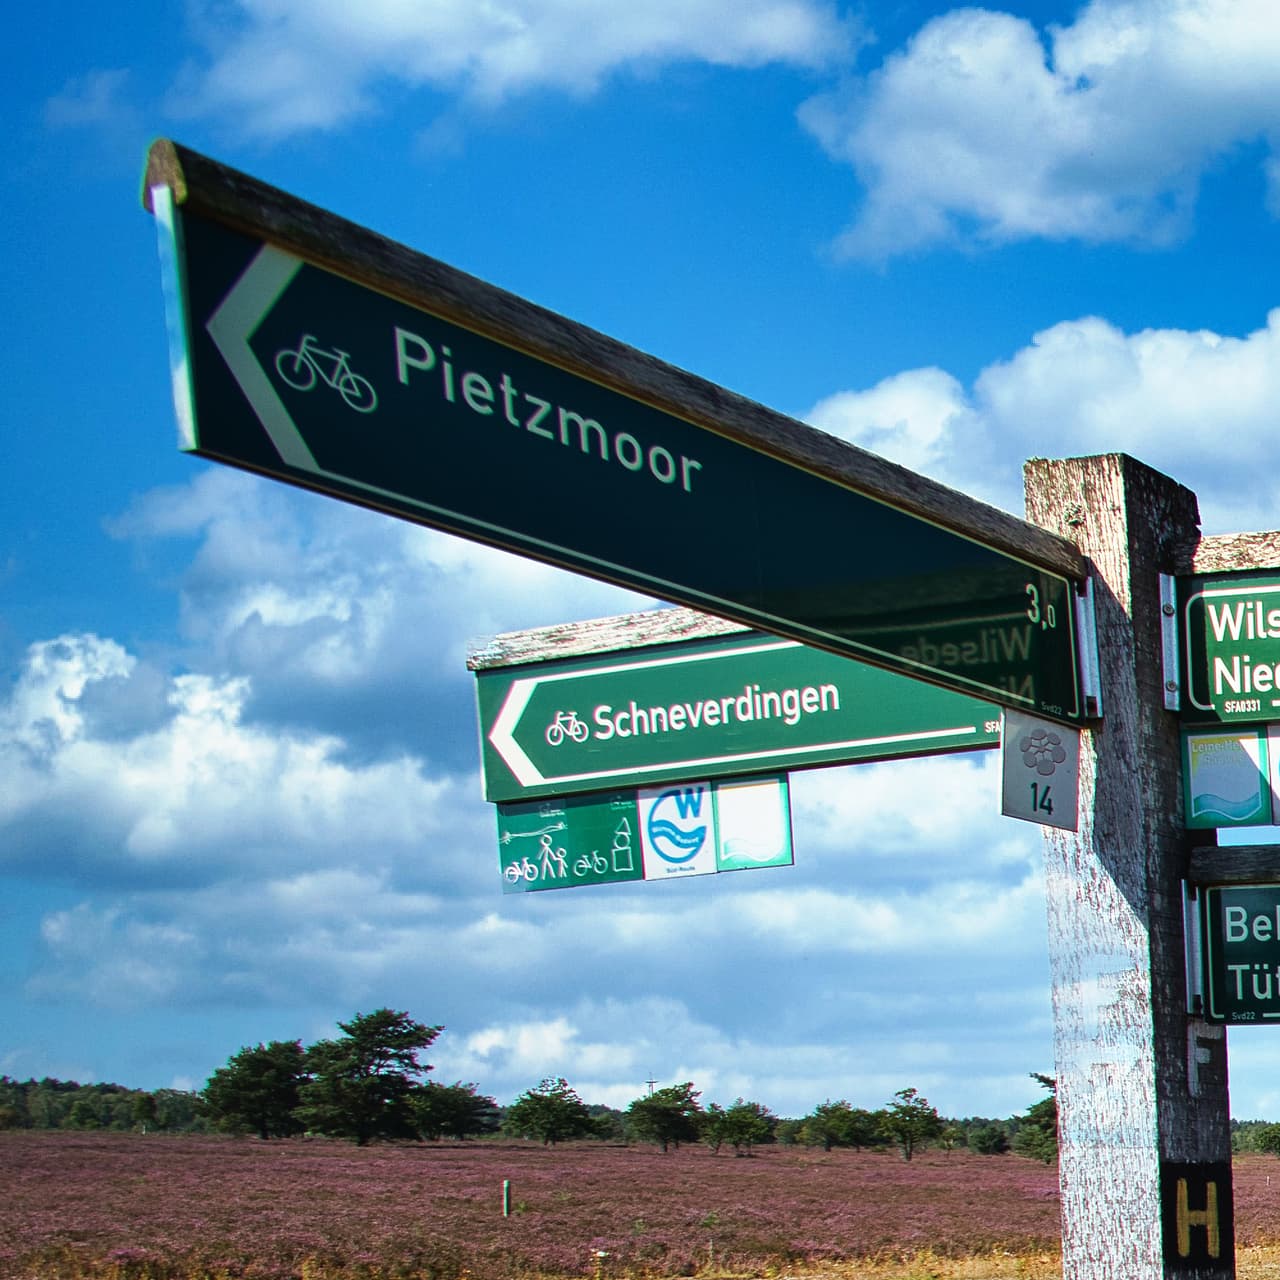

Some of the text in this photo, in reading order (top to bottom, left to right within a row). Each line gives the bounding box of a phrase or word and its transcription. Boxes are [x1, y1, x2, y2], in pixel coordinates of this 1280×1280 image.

[394, 326, 703, 492] Pietzmoor
[1026, 583, 1056, 631] 3,0
[593, 683, 841, 741] Schneverdingen
[1224, 699, 1261, 714] SFA0331
[1030, 782, 1054, 815] 14
[1176, 1177, 1220, 1259] H
